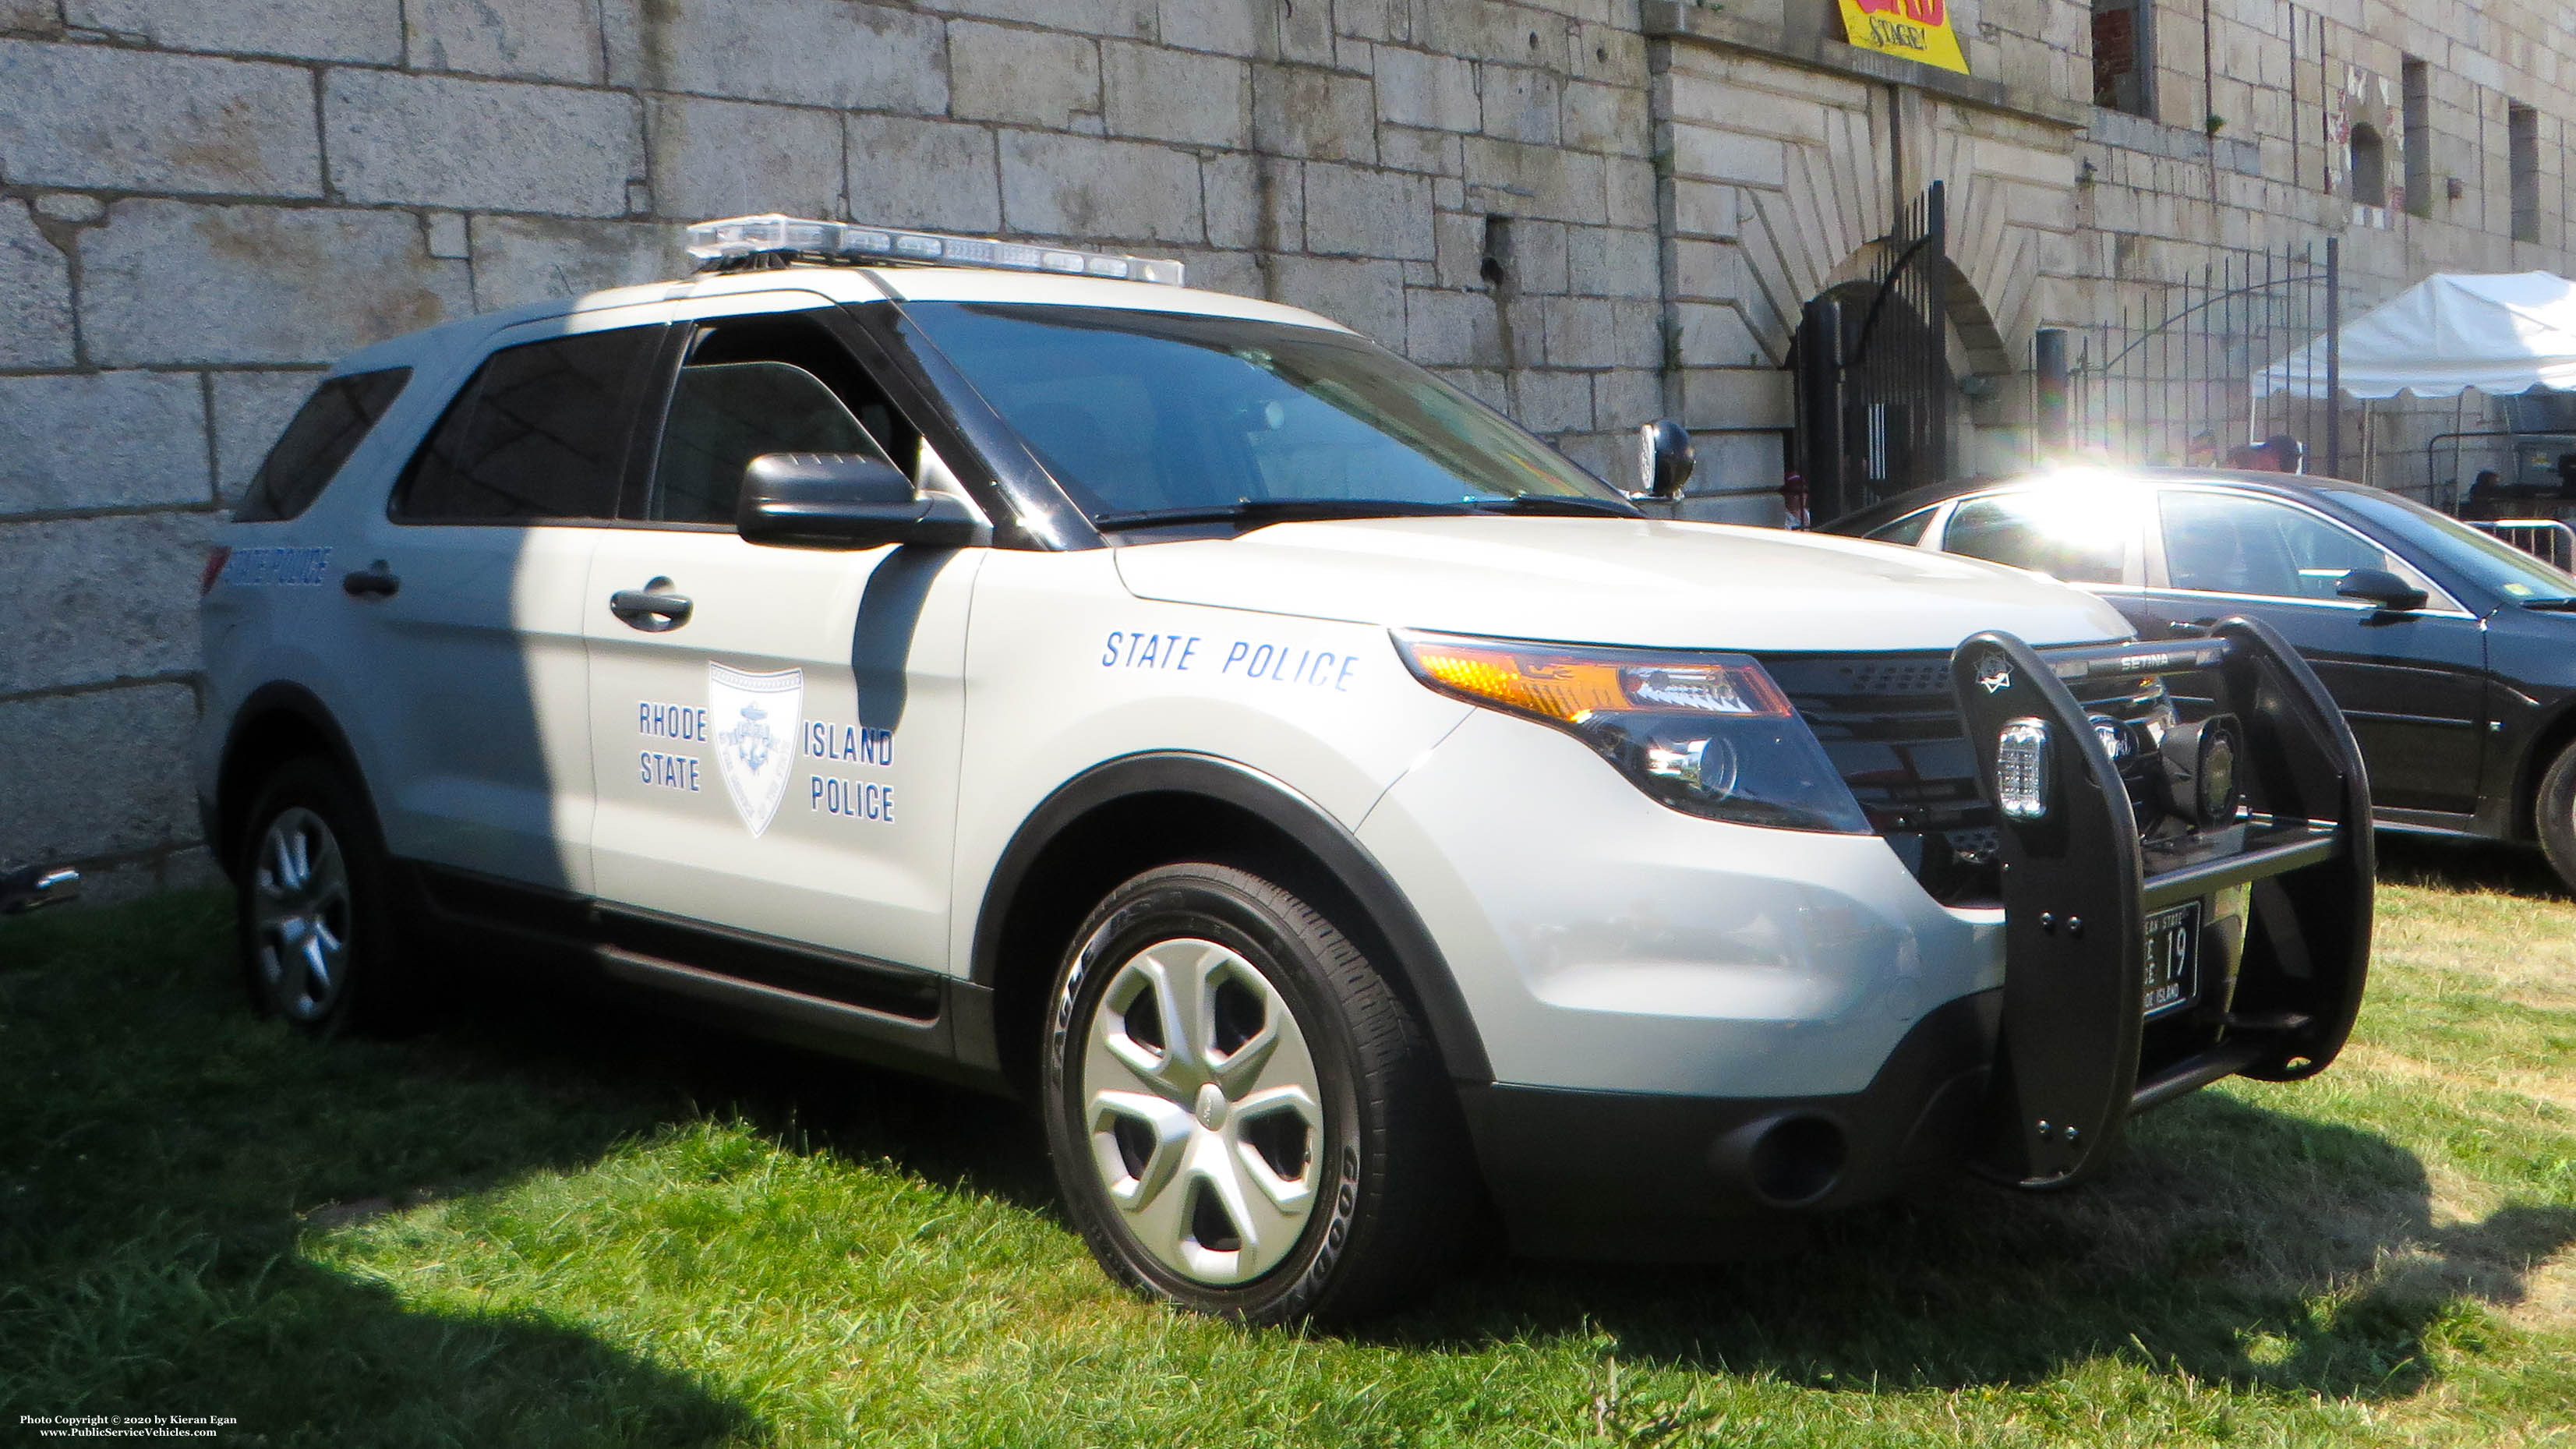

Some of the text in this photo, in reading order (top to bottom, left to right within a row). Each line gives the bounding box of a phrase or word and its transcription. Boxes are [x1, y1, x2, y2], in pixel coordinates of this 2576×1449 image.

[1868, 16, 1928, 51] STAGE!
[1102, 631, 1359, 692] STATE POLICE
[2120, 653, 2169, 670] SETINA
[639, 702, 895, 767] RHODE ISLAND
[640, 751, 701, 793] STATE
[811, 776, 895, 824] POLICE
[2163, 912, 2183, 929] STATE
[2166, 927, 2187, 981] 19
[2156, 983, 2180, 1004] ISLAND
